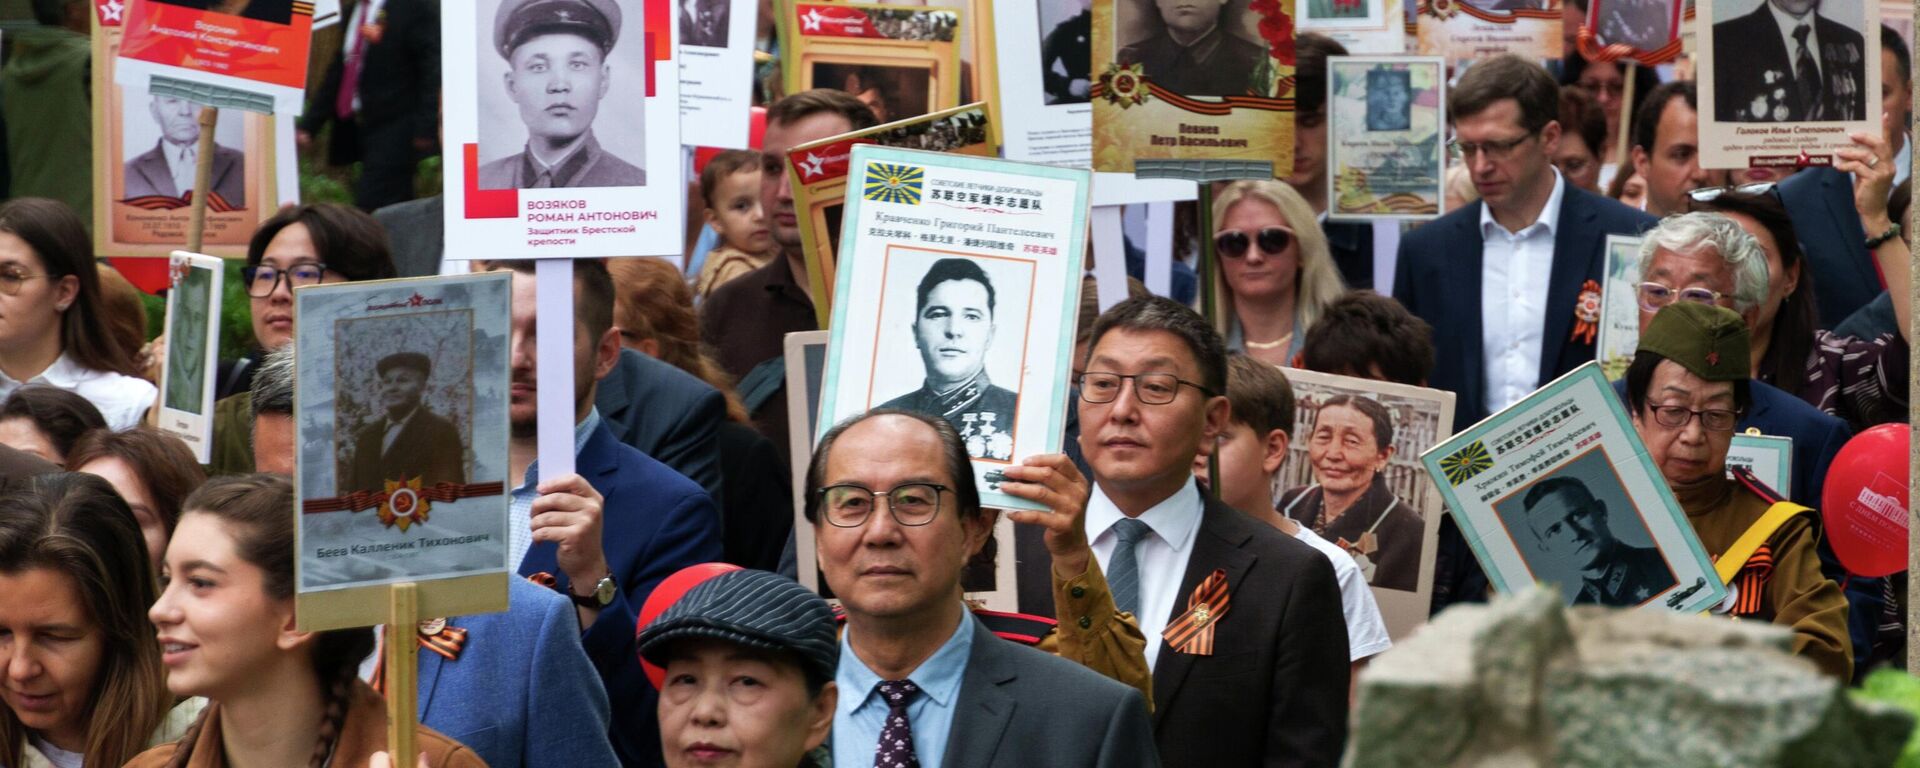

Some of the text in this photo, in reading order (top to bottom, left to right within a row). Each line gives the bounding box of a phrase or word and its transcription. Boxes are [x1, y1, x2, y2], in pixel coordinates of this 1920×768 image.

[150, 24, 198, 40] Анатолий
[1794, 125, 1845, 135] Степанович
[1150, 135, 1248, 148] Петр Васильевич
[527, 199, 587, 210] ВОЗЯКОВ
[930, 188, 1042, 211] 苏联空军援华志愿队
[527, 210, 658, 223] РОМАН АНТОНОВИЧ
[527, 225, 636, 236] Защитник Брестской
[875, 211, 1055, 240] Кравченко Григорий Пантелеевич
[527, 238, 576, 247] крепости
[1473, 421, 1596, 492] Хрюкин Тимофей Тимофеевич
[316, 533, 489, 559] Беев Калленик Тихонович
